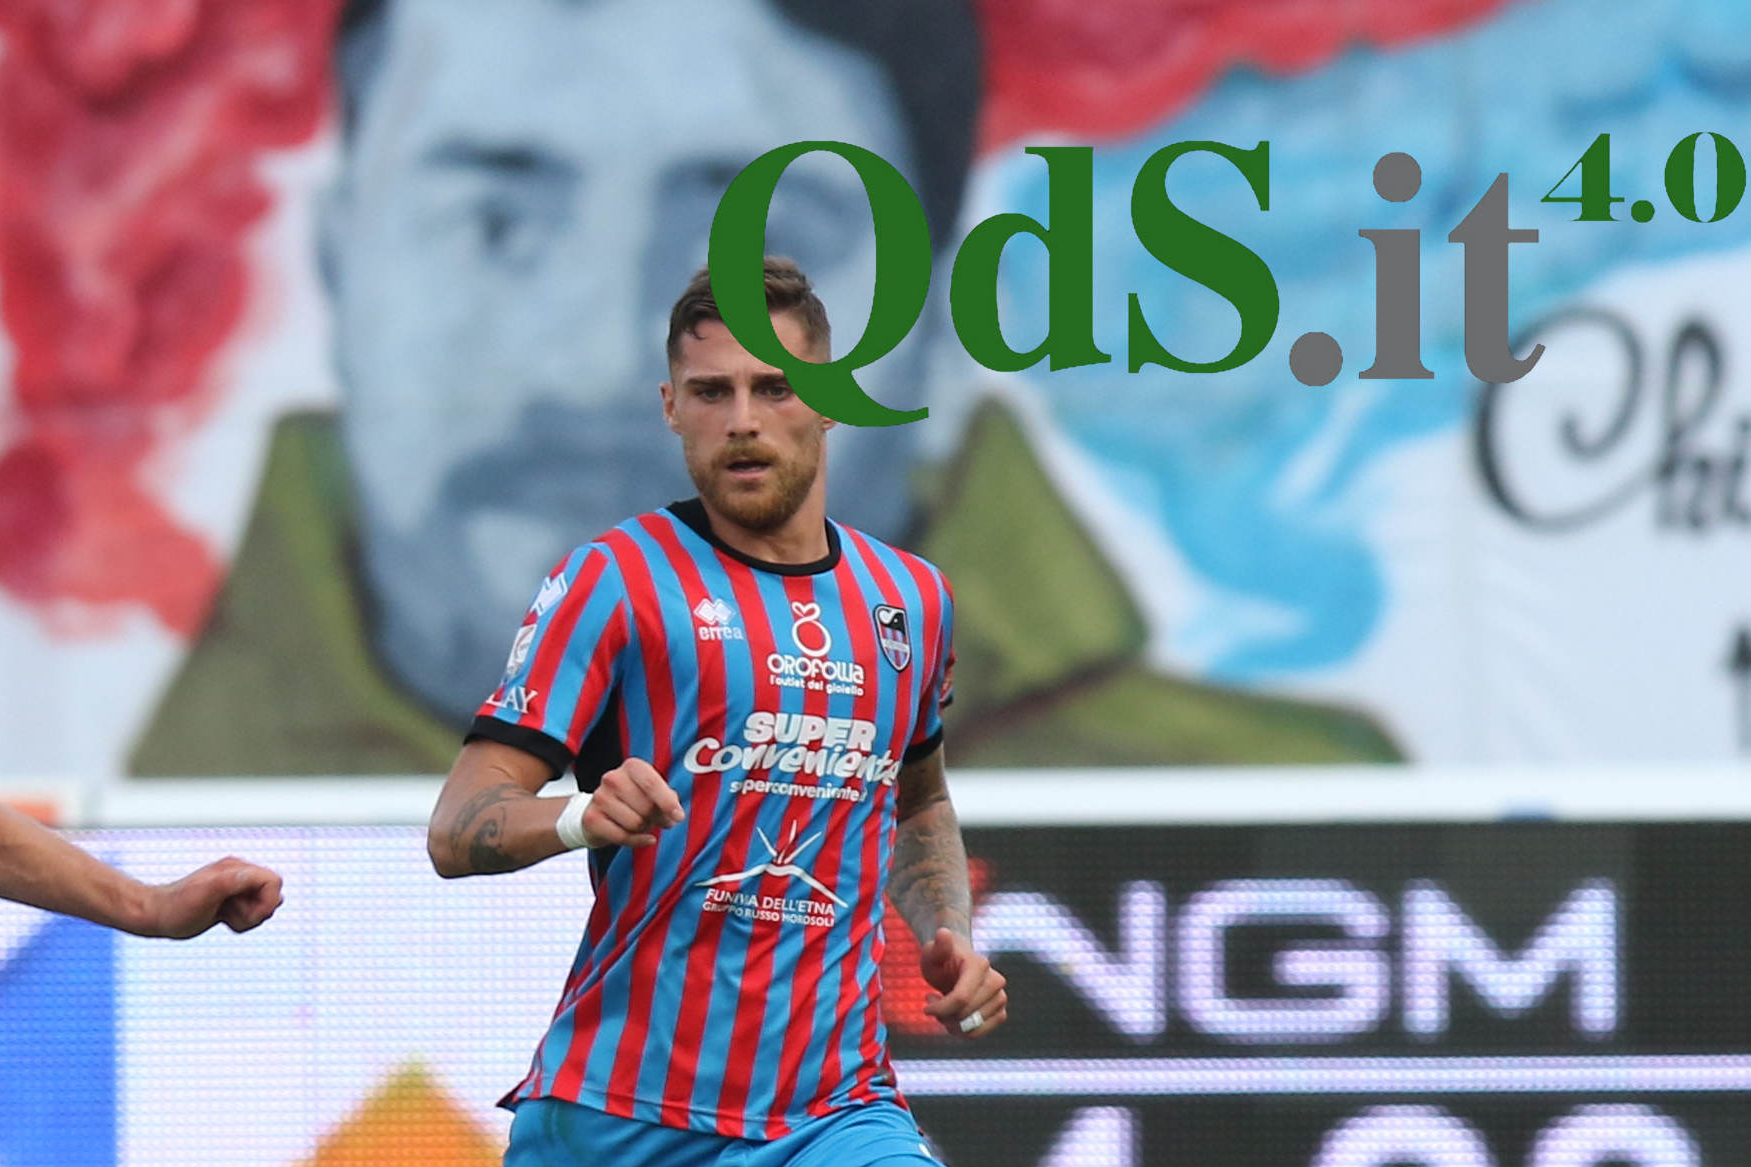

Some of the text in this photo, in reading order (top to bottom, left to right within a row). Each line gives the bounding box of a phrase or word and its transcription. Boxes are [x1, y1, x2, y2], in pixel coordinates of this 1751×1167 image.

[743, 711, 877, 752] SUPER
[683, 737, 900, 787] Conveniente
[744, 908, 781, 922] RUSSO
[762, 896, 835, 916] DELL'ETNA
